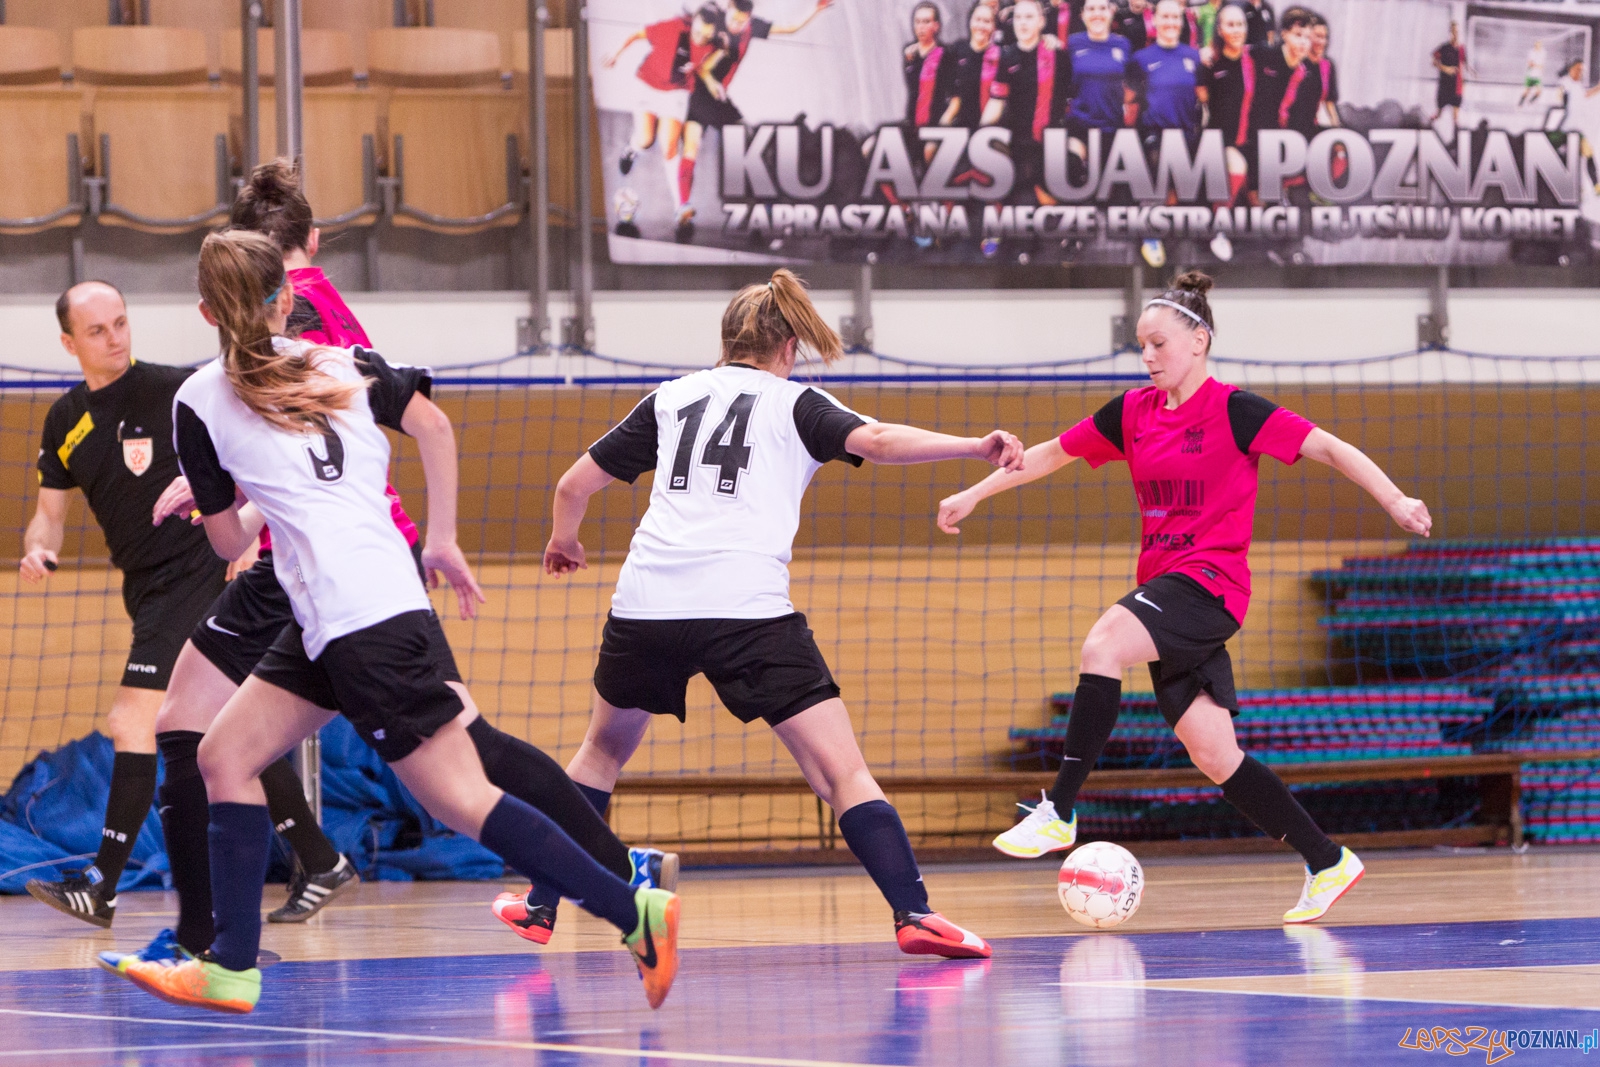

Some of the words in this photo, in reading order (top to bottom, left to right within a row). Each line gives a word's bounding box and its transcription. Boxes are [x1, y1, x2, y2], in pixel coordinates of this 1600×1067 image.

[722, 125, 833, 198] KU
[861, 126, 1015, 199] AZS
[1043, 127, 1230, 200] UAM
[1257, 107, 1581, 203] POZNAŃ
[723, 203, 908, 236] ZAPRASZA
[919, 204, 970, 236] NA
[983, 204, 1097, 236] MECZE
[1107, 205, 1300, 236] EKSTRALIGI
[1460, 207, 1581, 238] KOBIET
[667, 389, 762, 498] 14
[1122, 865, 1139, 912] SELECT
